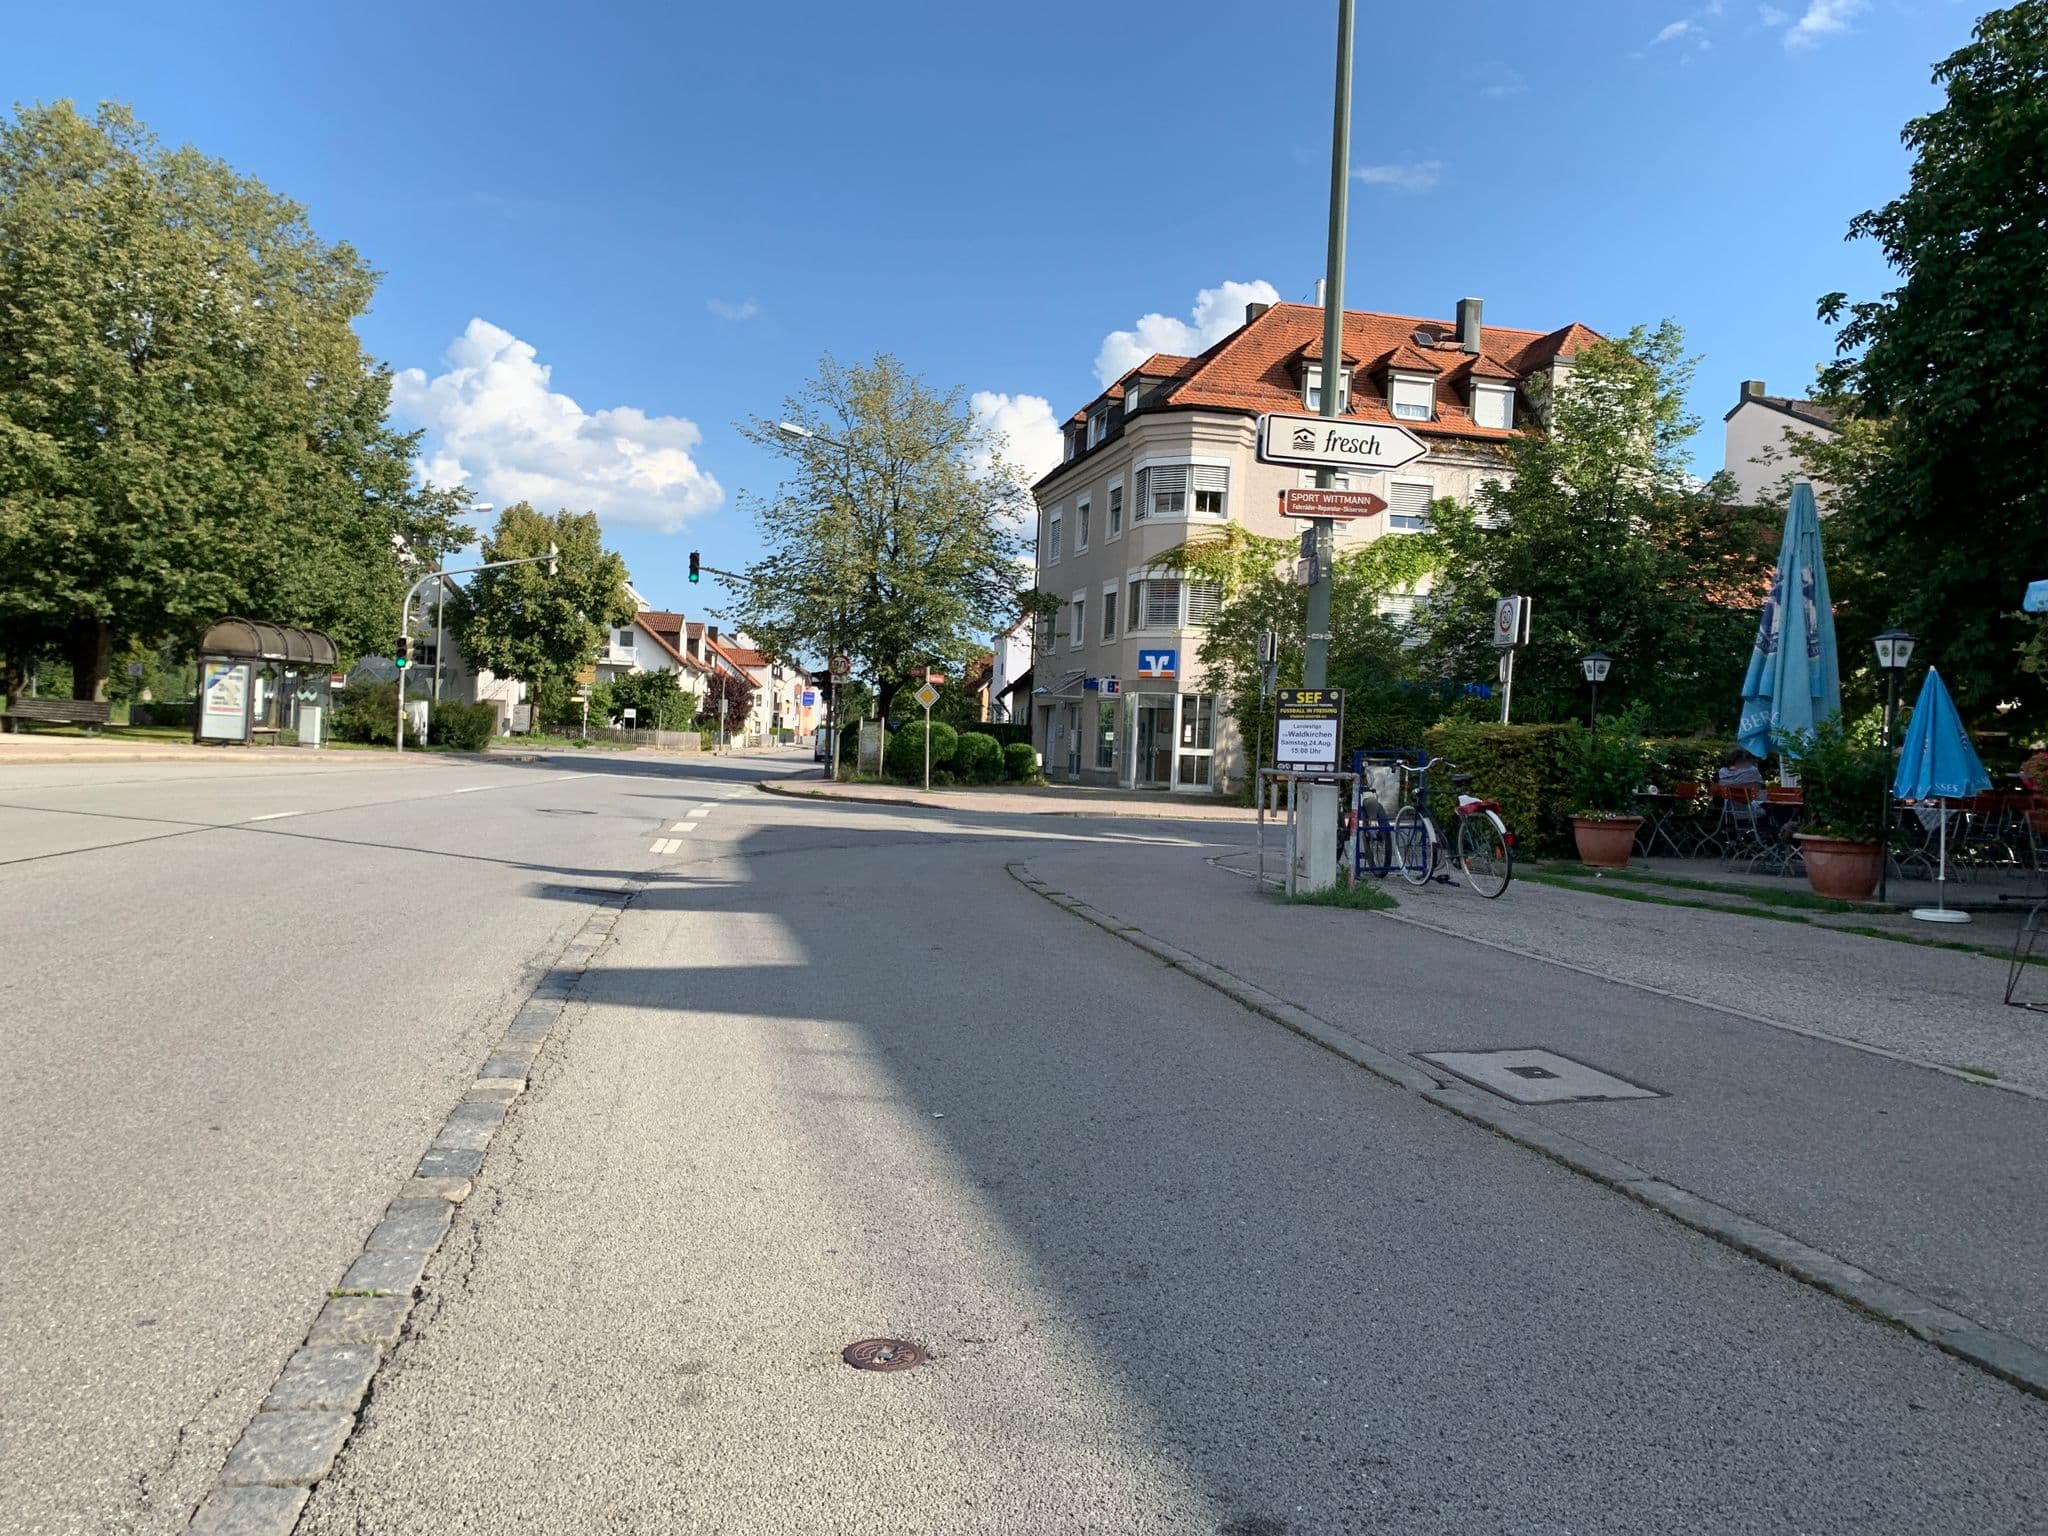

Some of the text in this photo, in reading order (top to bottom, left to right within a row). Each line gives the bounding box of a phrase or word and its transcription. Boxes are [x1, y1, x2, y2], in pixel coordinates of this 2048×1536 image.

[1323, 429, 1382, 456] fresch
[1290, 492, 1371, 505] SPORT WITTMANN
[1297, 692, 1322, 703] SEF
